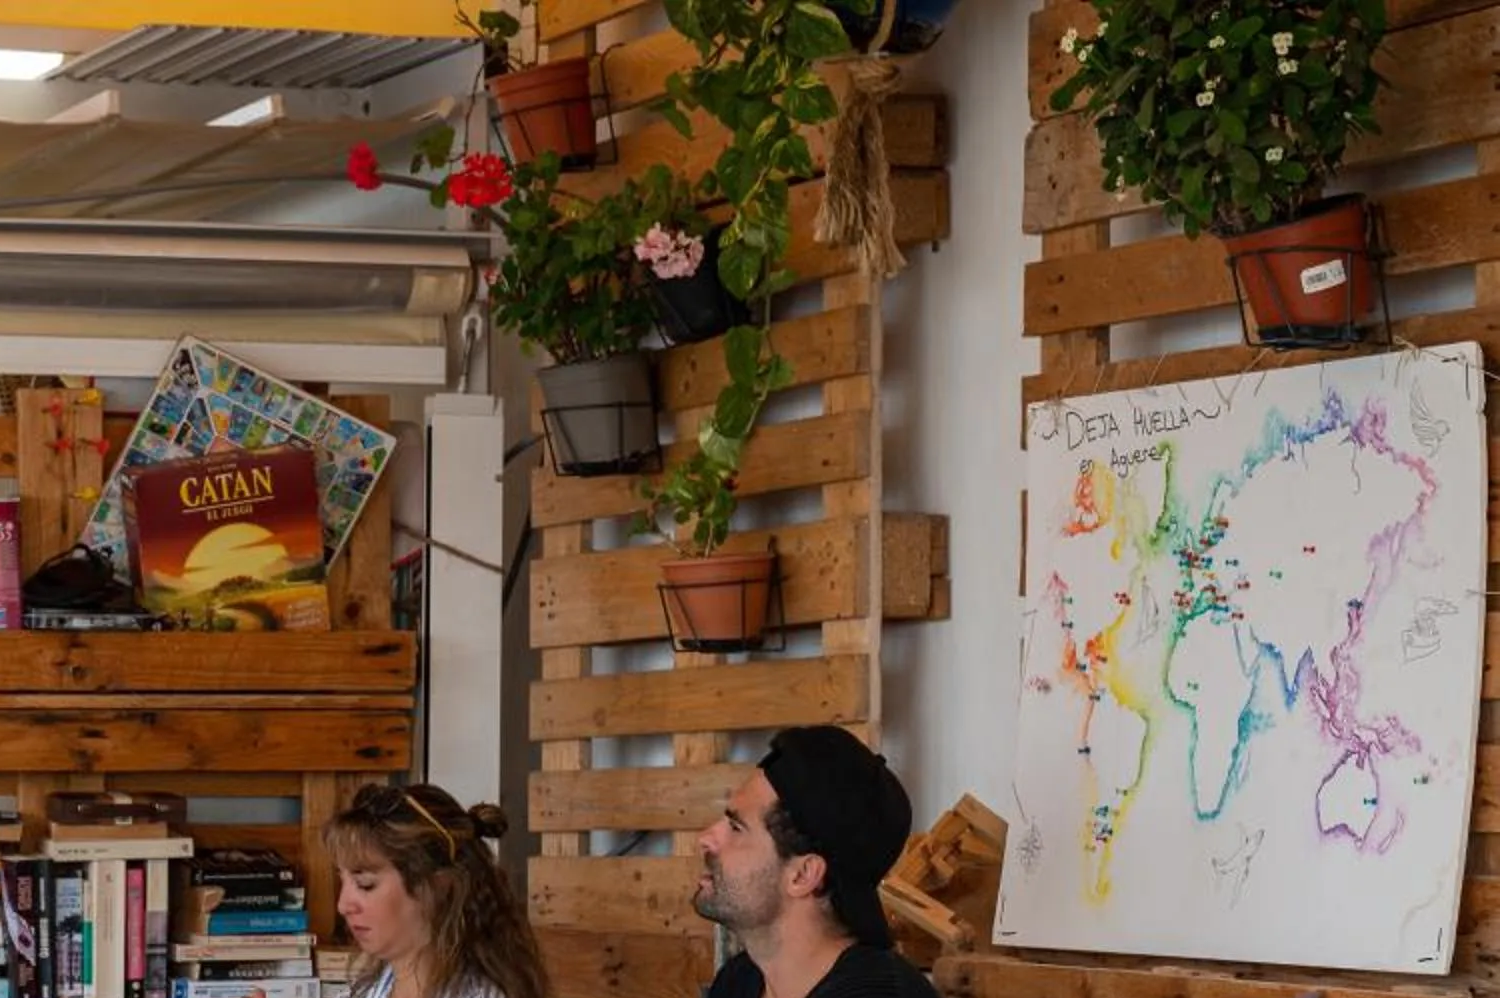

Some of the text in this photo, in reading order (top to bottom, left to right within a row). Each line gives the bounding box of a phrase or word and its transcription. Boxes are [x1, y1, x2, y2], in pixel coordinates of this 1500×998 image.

[1065, 406, 1191, 451] DEJA HUELLA
[179, 466, 273, 507] CATAN
[221, 504, 254, 519] JUEGO
